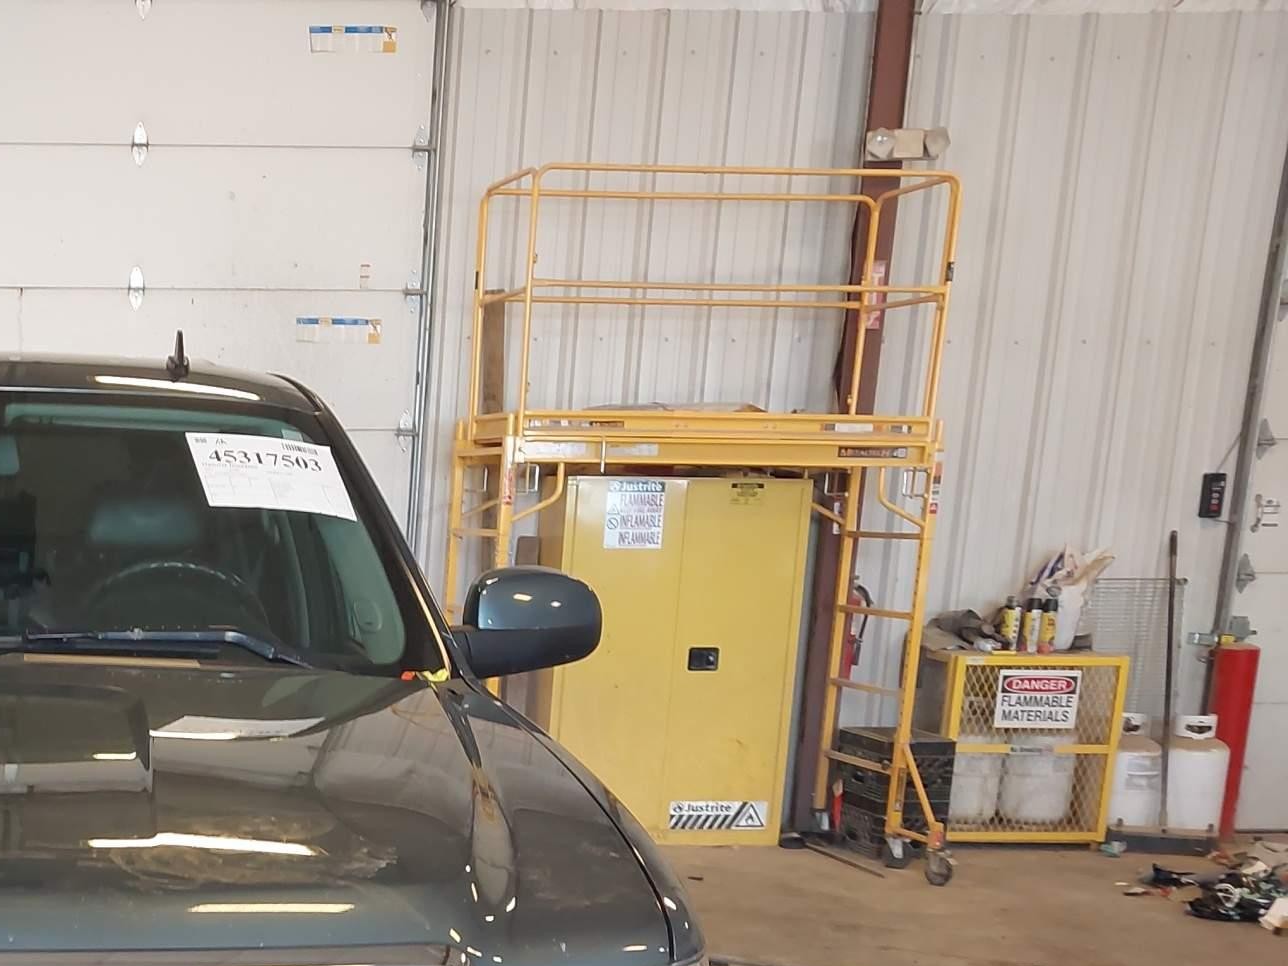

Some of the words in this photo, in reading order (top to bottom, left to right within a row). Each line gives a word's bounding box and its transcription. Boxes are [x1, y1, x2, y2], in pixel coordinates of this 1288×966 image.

[208, 449, 322, 472] 45317503
[621, 481, 664, 492] Justrite
[620, 493, 665, 507] FLAMMABLE
[1011, 679, 1068, 691] DANGER
[1001, 695, 1074, 708] FLAMMABLE
[1000, 709, 1070, 722] MATERIALS
[684, 803, 731, 812] Justrite
